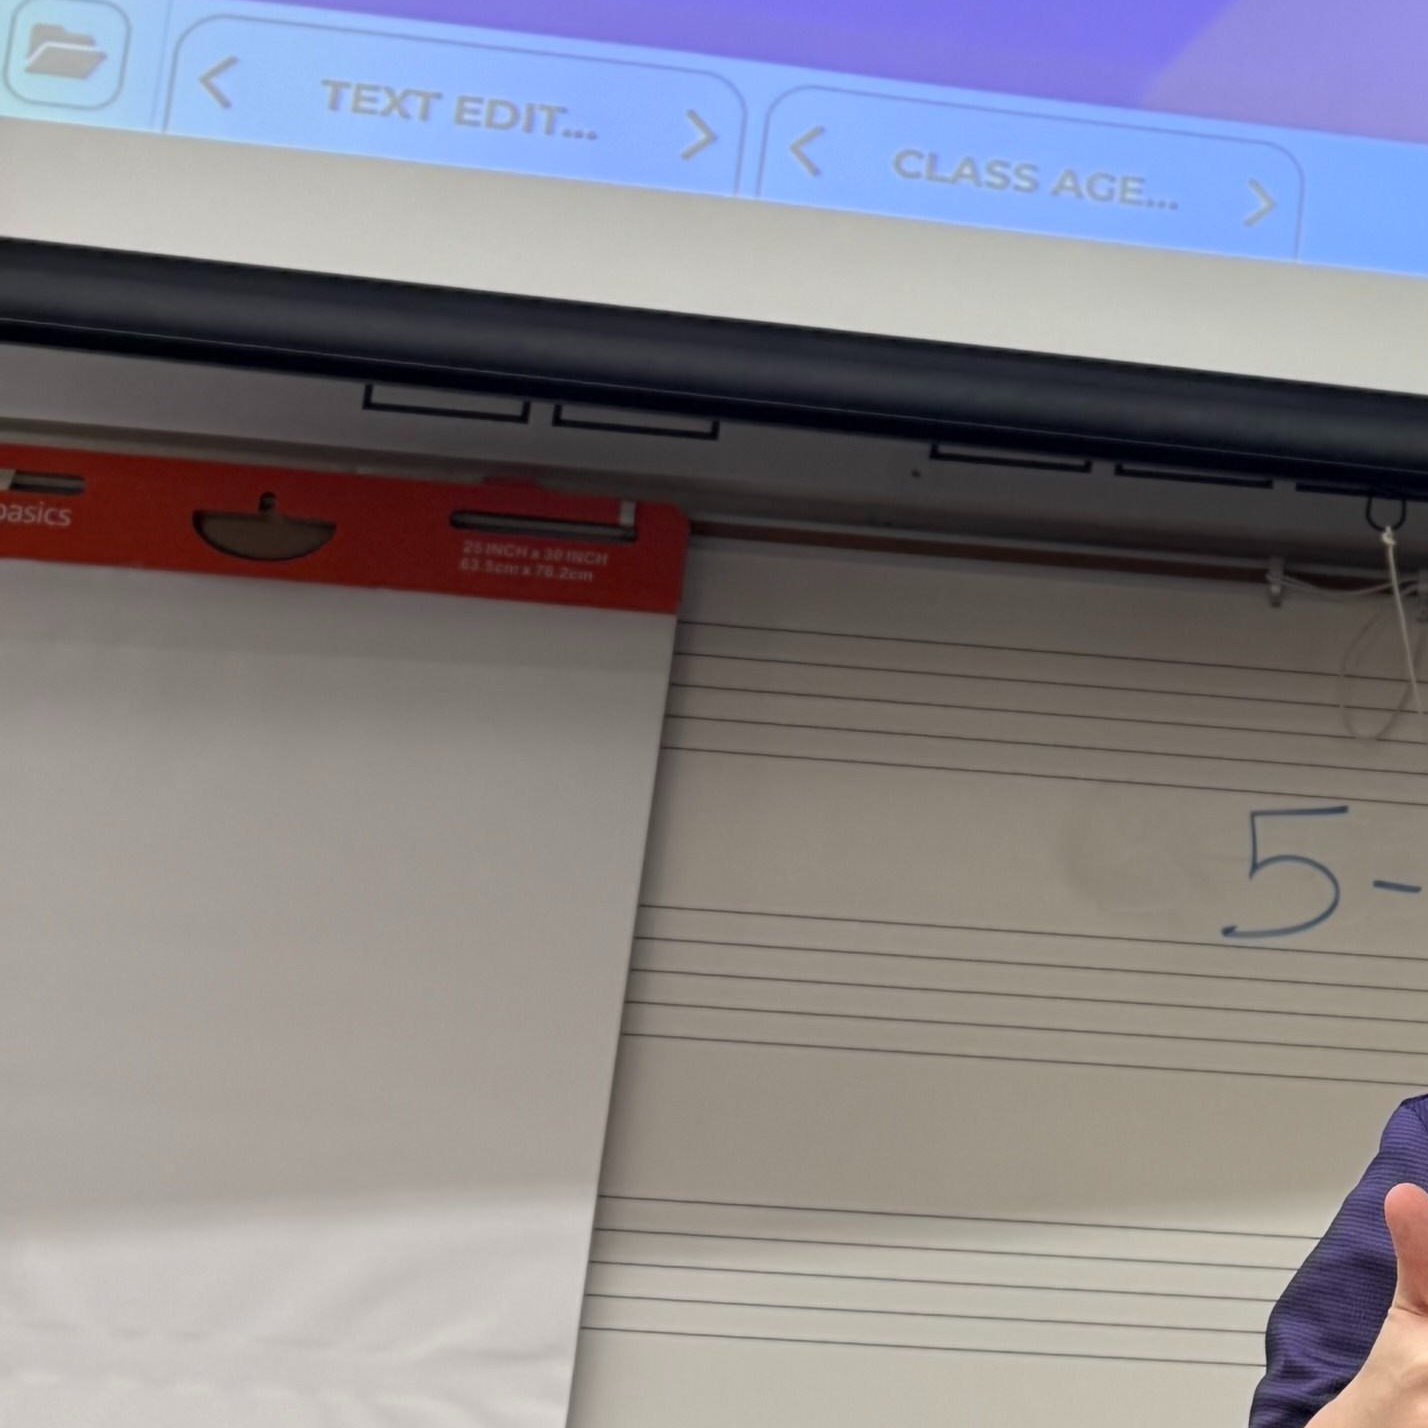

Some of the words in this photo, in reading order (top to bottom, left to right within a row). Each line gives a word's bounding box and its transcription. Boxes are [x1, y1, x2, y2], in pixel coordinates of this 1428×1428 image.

[321, 79, 442, 123] TEXT
[453, 95, 598, 143] EDIT...
[893, 149, 1039, 193] CLASS
[1050, 169, 1179, 211] AGE...
